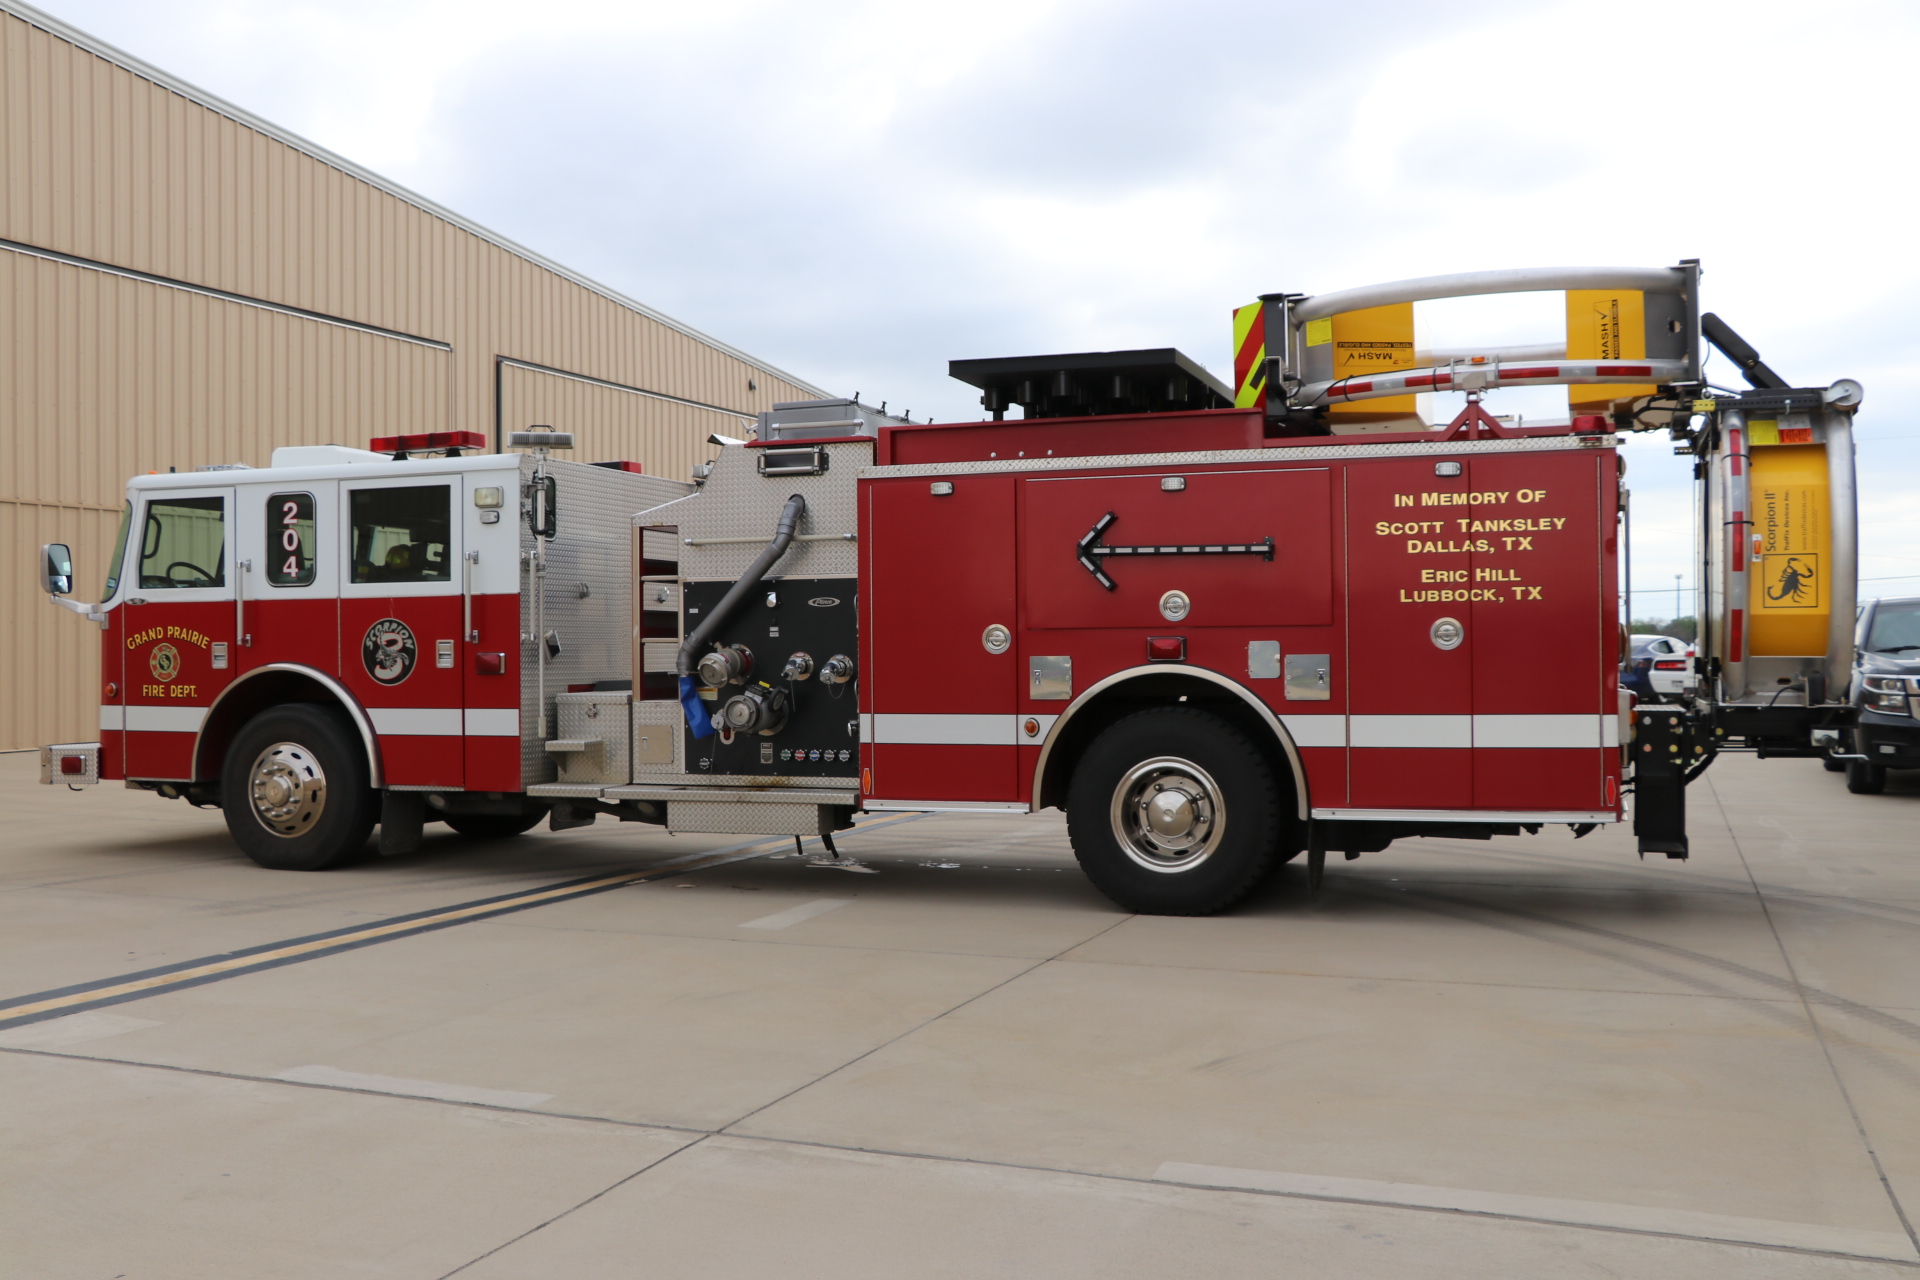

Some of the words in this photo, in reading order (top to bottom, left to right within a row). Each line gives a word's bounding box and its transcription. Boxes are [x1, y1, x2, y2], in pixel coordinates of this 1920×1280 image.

[1601, 323, 1610, 360] MASH
[1358, 352, 1393, 360] MASH
[1764, 501, 1778, 552] Scorpion
[282, 501, 299, 578] 204
[1502, 536, 1533, 551] TX
[1511, 586, 1543, 600] TX
[127, 626, 164, 650] GRAND
[167, 625, 210, 649] PRAIRIE
[365, 621, 415, 651] SCORPION
[142, 684, 165, 697] FIRE
[170, 685, 198, 698] DEPT.
